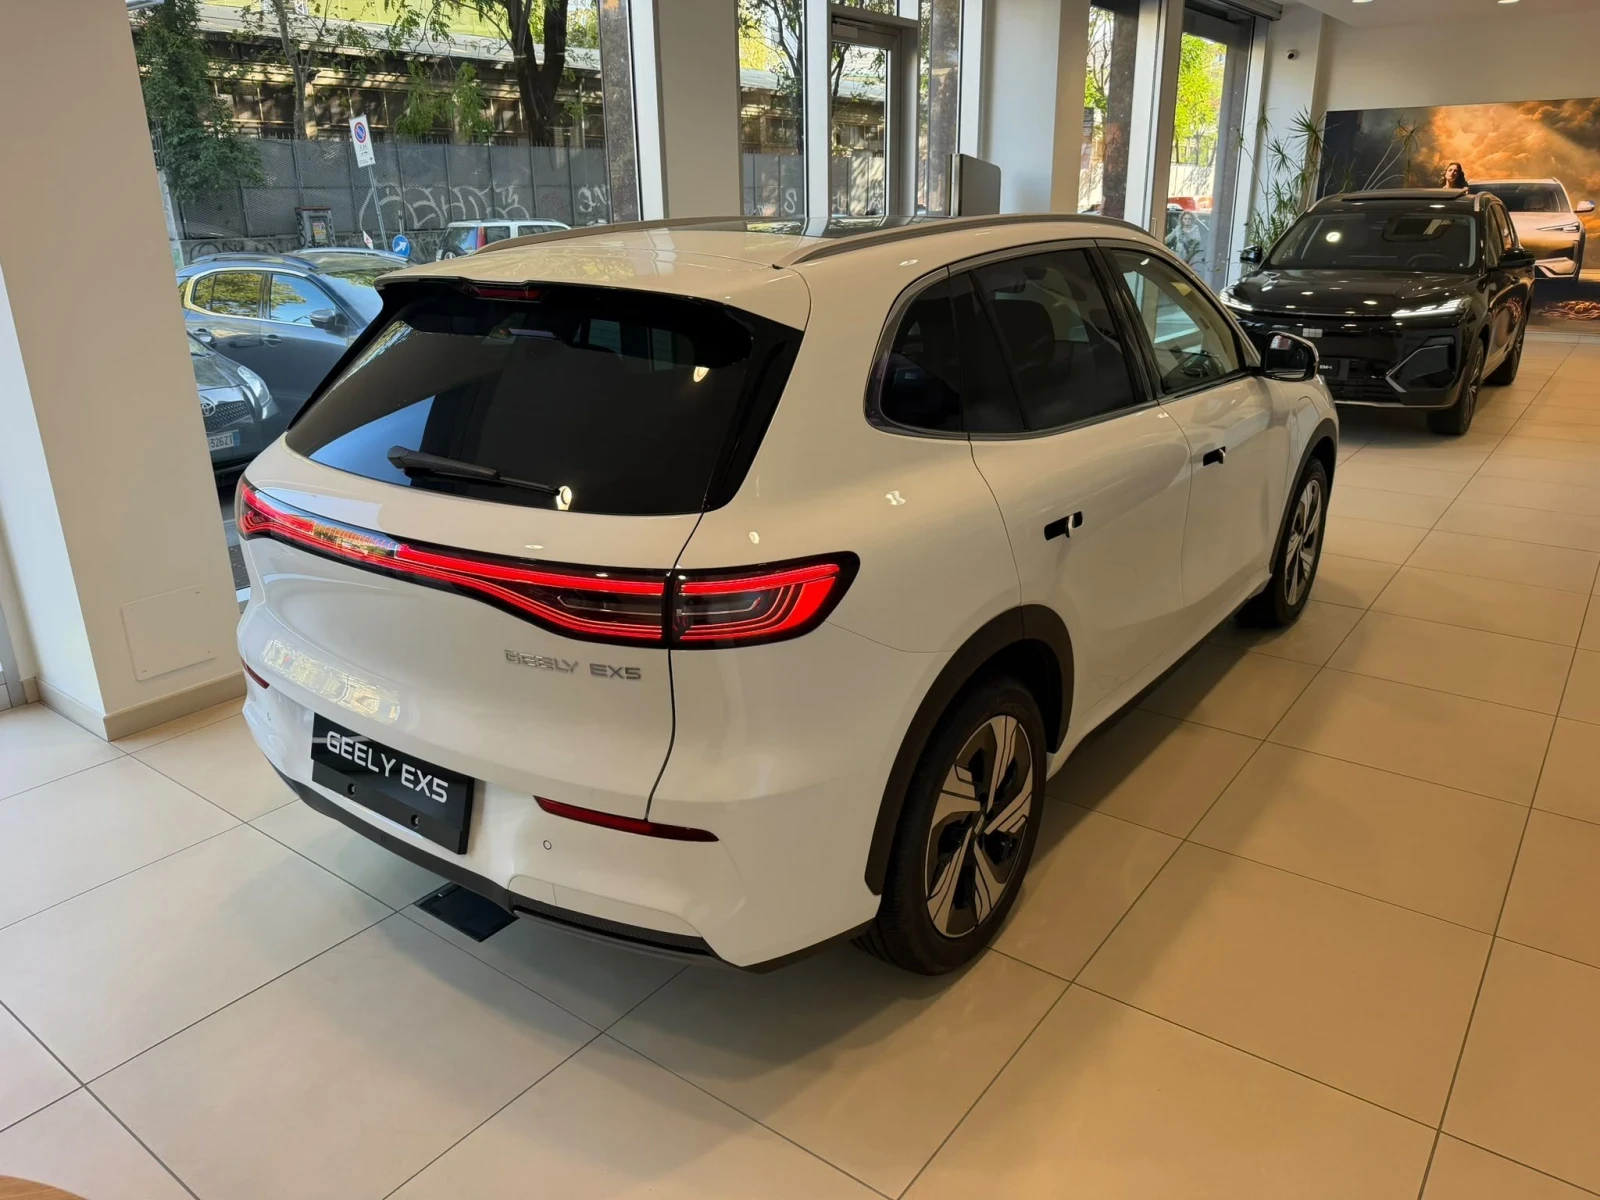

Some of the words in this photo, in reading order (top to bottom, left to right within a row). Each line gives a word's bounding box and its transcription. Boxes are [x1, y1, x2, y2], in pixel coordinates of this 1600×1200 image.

[504, 649, 579, 674] GEELY
[589, 663, 642, 680] EX5
[326, 730, 396, 777] GEELY
[401, 763, 449, 803] EX5
